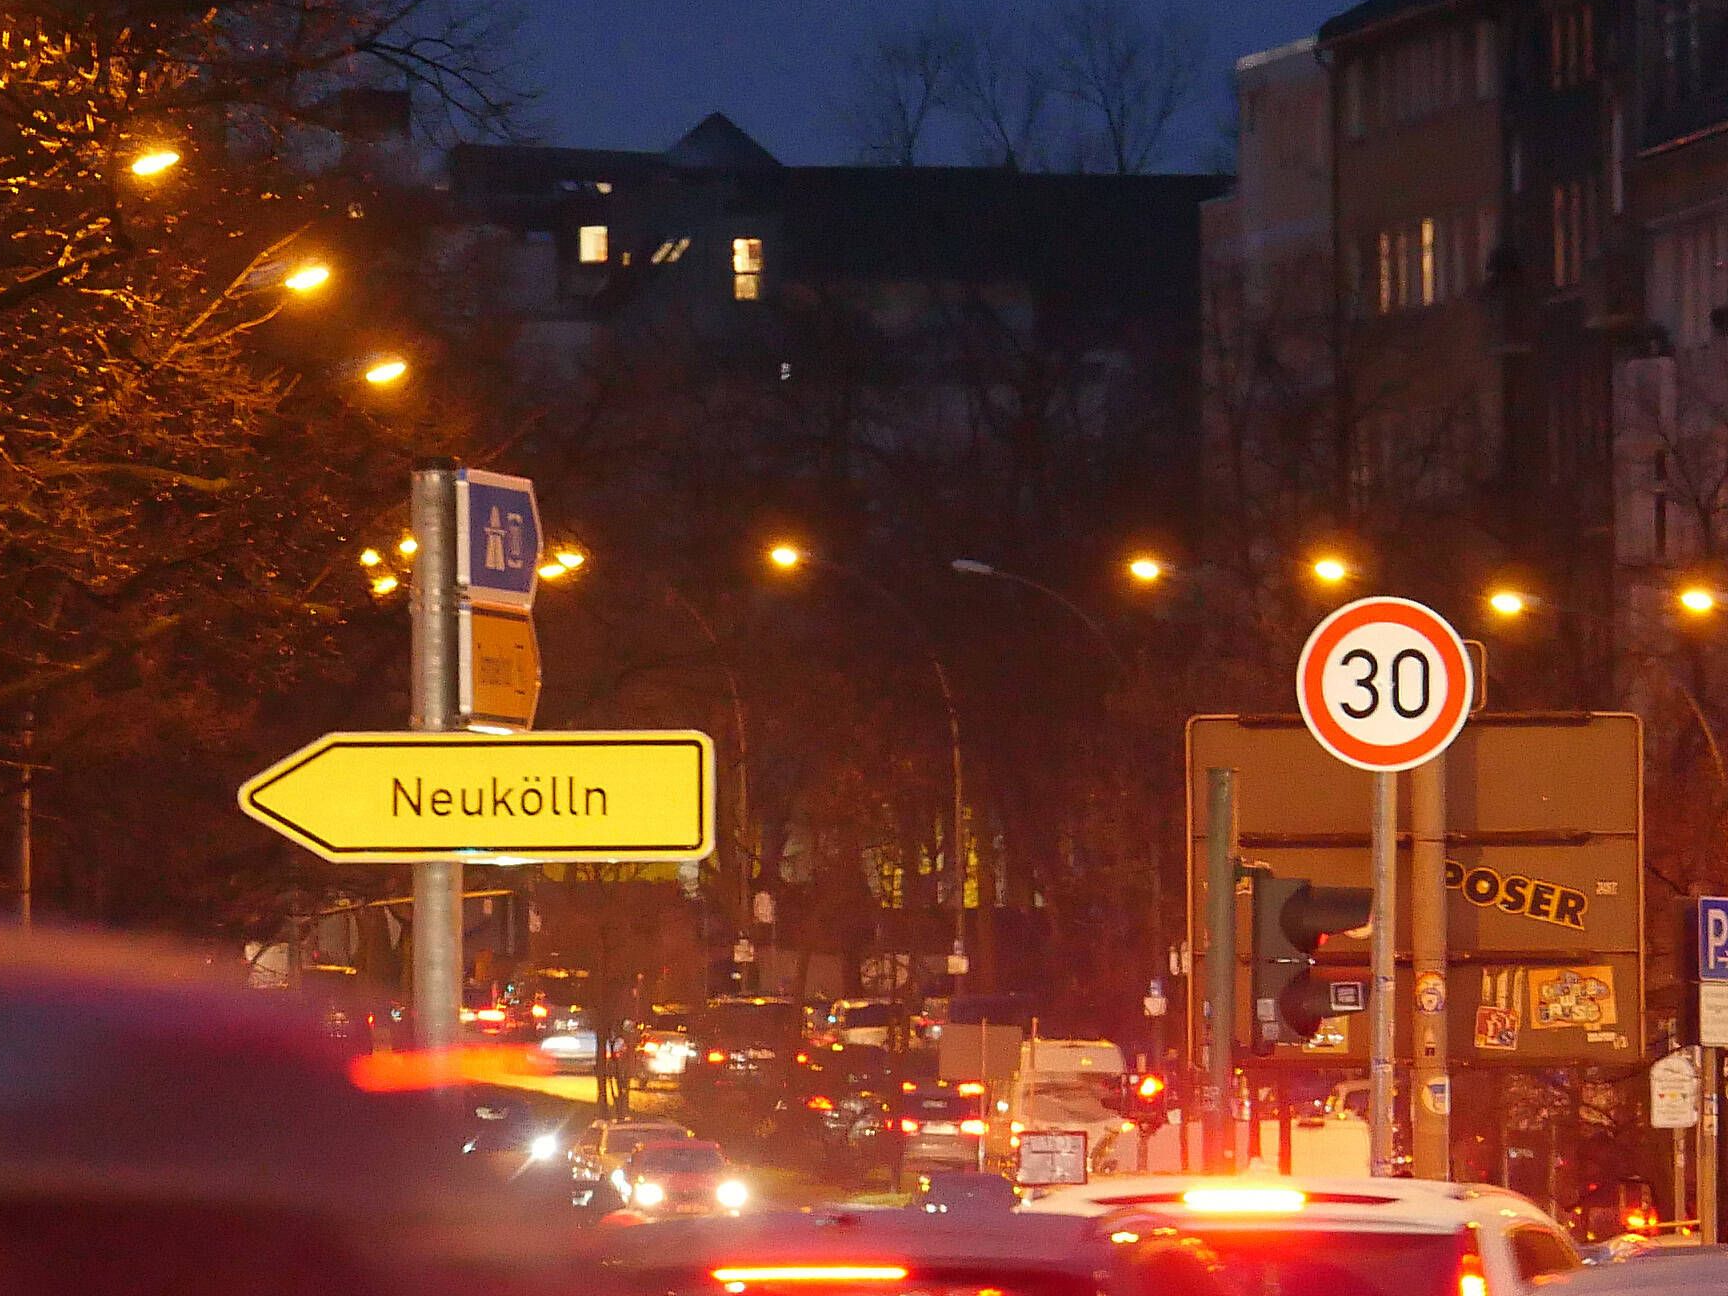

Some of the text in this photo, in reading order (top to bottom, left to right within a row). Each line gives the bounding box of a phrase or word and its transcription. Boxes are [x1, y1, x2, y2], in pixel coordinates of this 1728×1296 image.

[1340, 649, 1430, 719] 30
[392, 776, 607, 816] Neukölln
[1707, 909, 1728, 969] P
